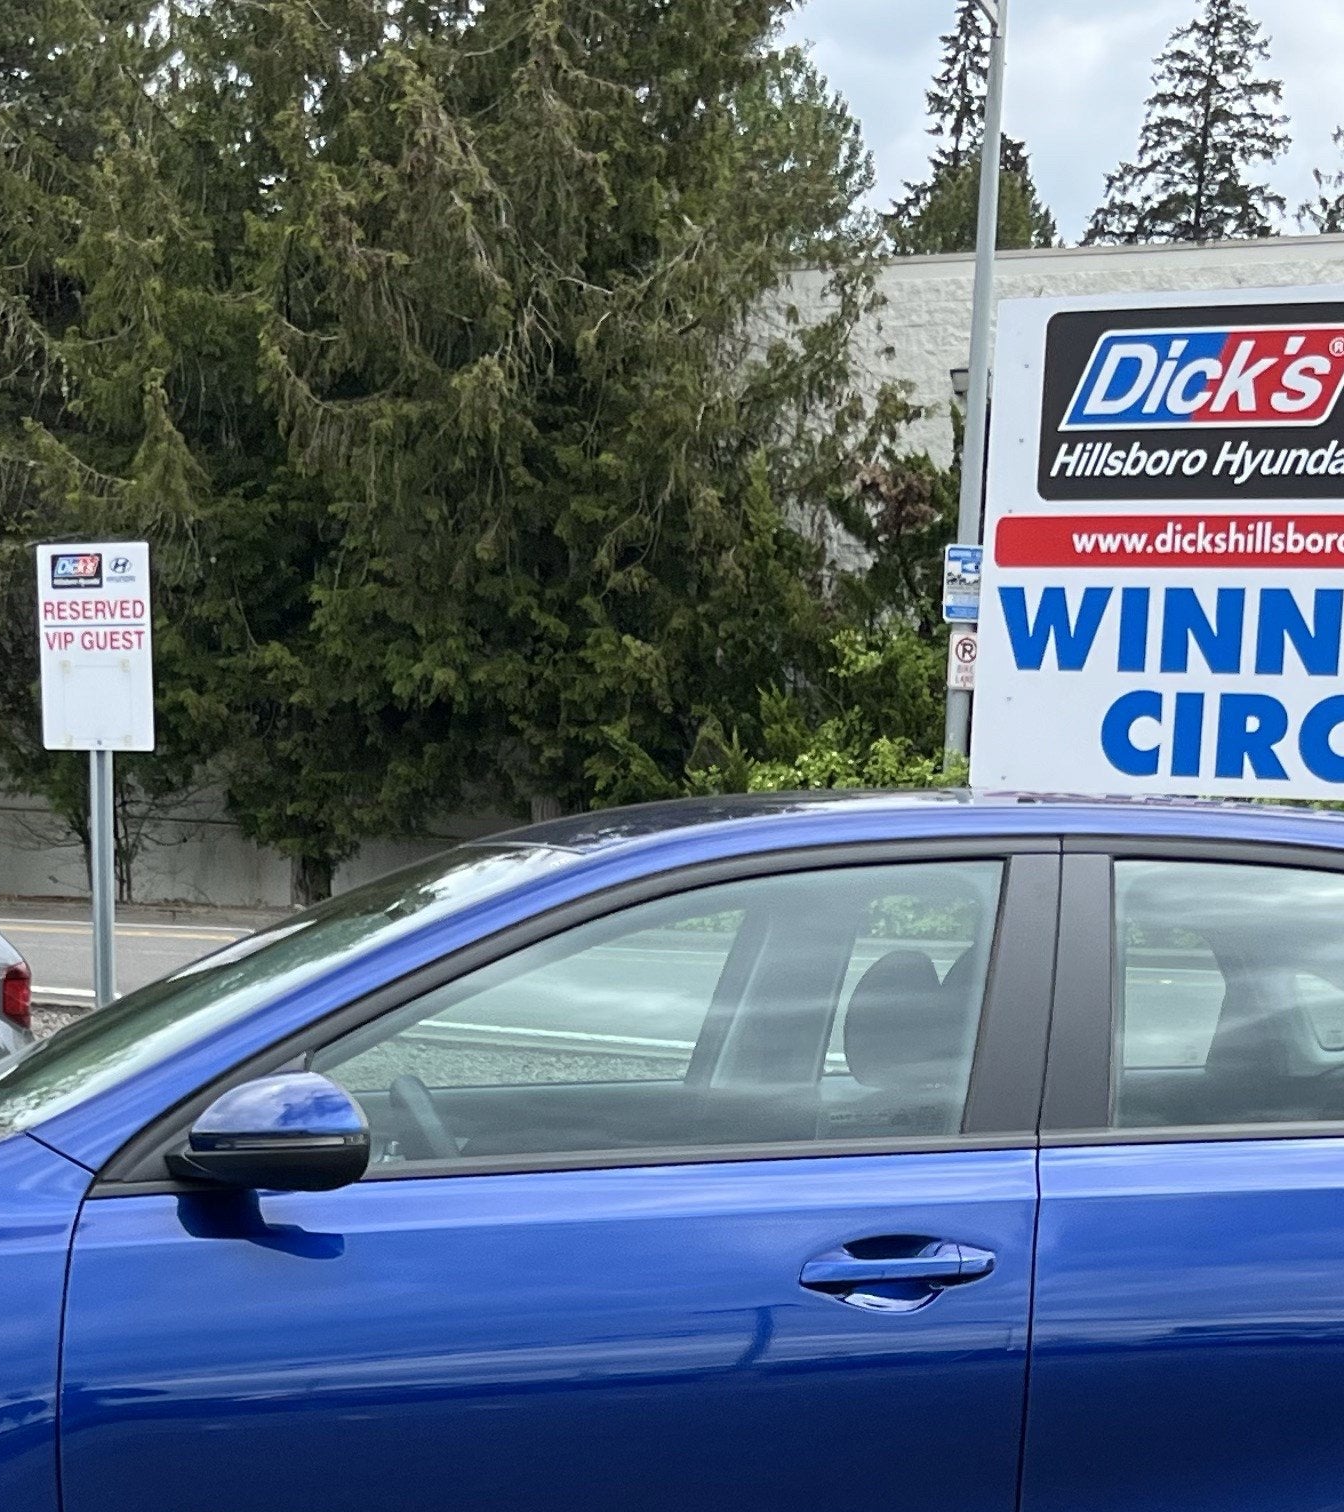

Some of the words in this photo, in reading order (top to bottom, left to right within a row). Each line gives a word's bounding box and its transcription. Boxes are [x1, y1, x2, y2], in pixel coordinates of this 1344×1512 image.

[1049, 441, 1208, 478] Hillsboro
[43, 600, 145, 620] RESERVED
[45, 631, 74, 650] VIP
[81, 631, 145, 650] GUEST
